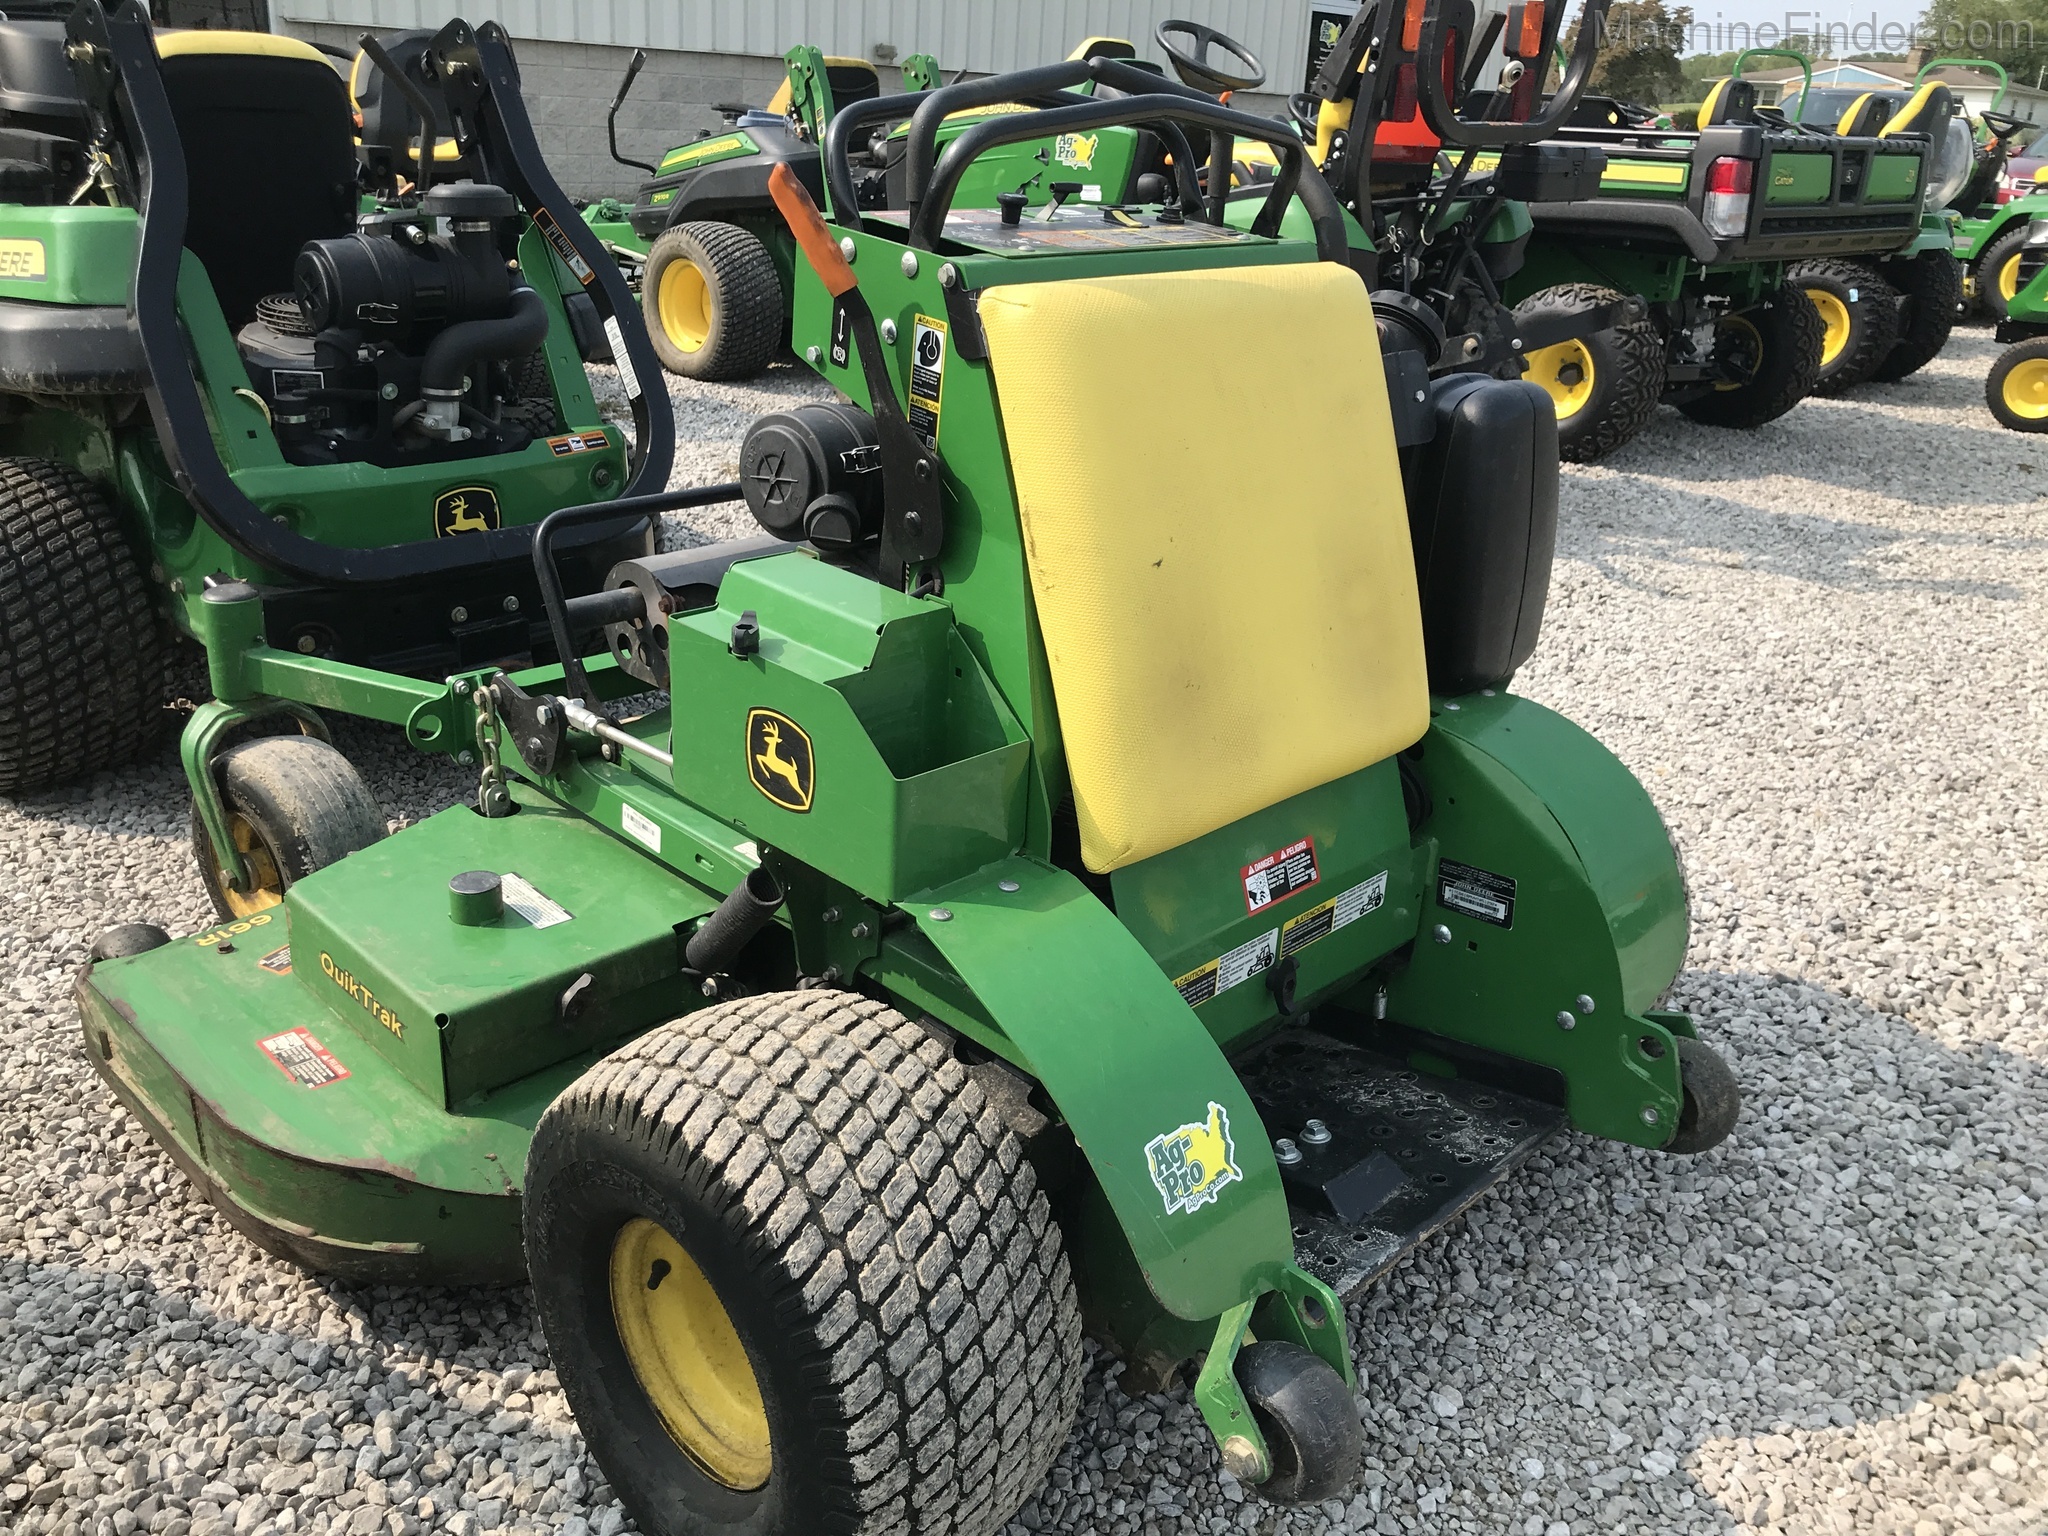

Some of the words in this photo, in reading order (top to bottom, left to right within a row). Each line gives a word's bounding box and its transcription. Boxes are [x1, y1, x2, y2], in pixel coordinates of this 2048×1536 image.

[1057, 146, 1077, 158] Pro
[1058, 135, 1077, 147] Ag-
[922, 317, 945, 330] CAUTION
[1253, 856, 1275, 872] DANGER
[1286, 840, 1307, 857] PELIGRO
[196, 915, 272, 946] 661R
[1179, 967, 1206, 986] CAUTION
[319, 951, 403, 1039] QuikTrak
[1150, 1135, 1193, 1179] Ag-
[1161, 1159, 1204, 1208] Pro
[1187, 1171, 1230, 1209] AgProCo.com
